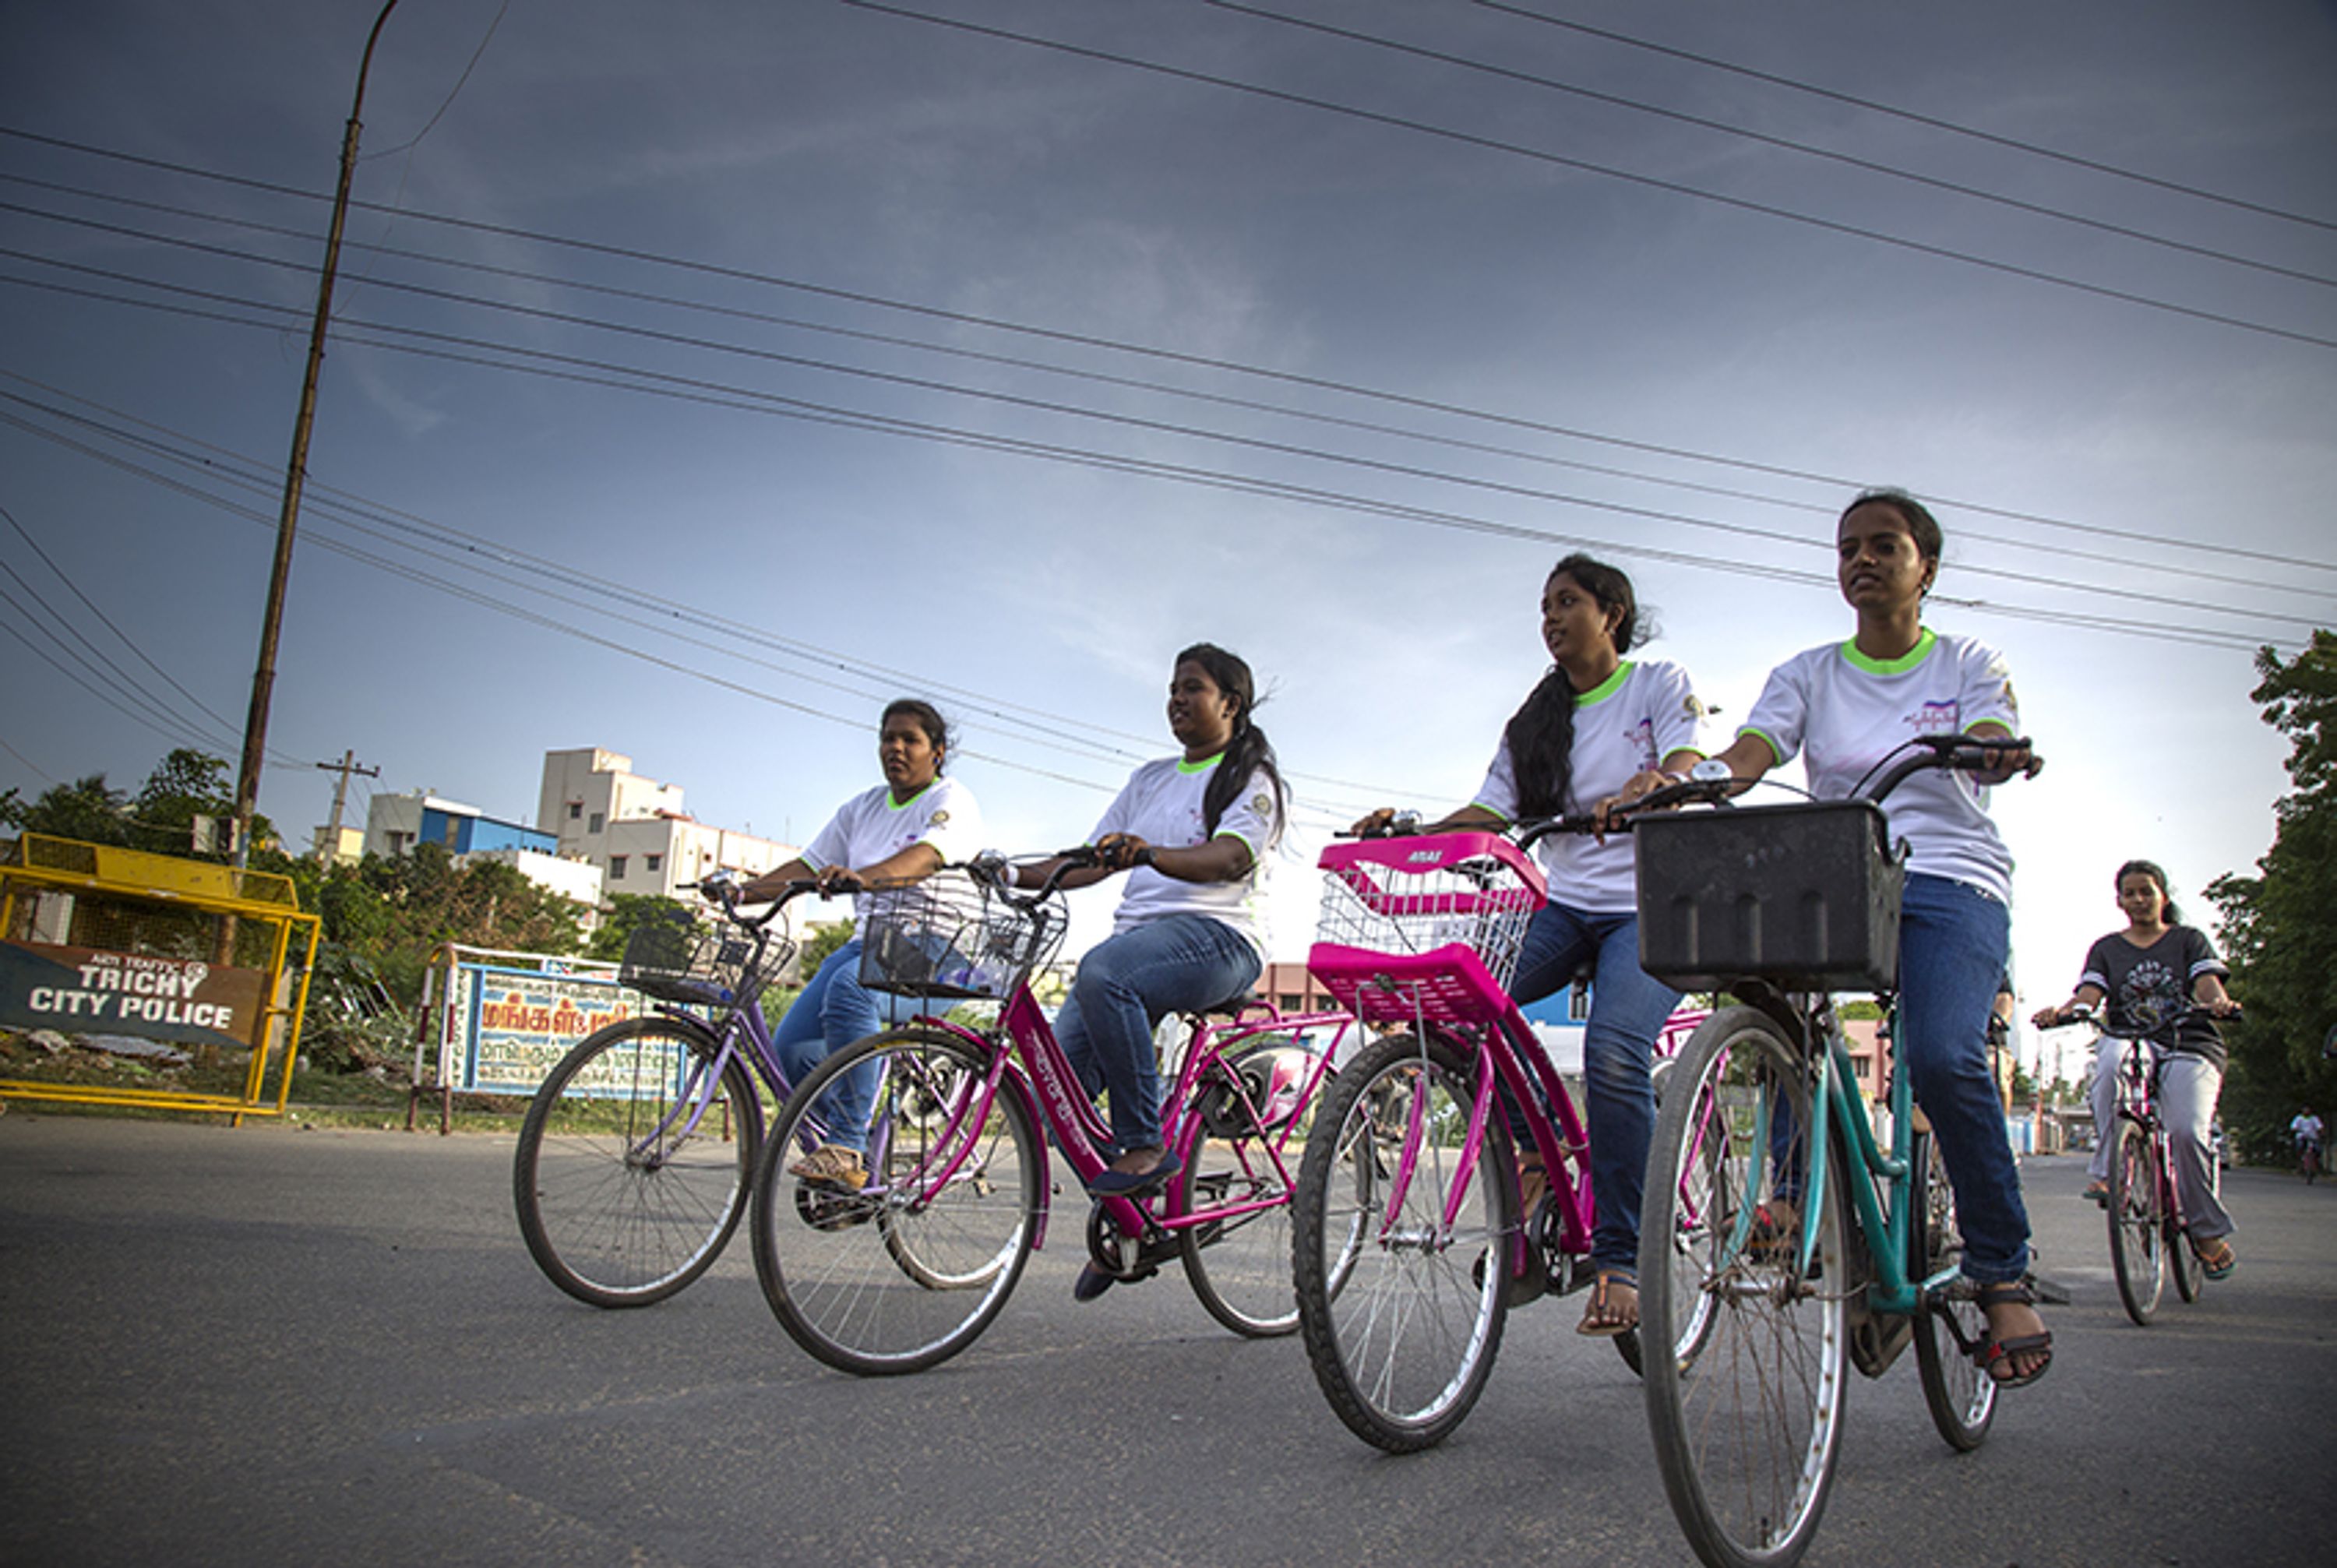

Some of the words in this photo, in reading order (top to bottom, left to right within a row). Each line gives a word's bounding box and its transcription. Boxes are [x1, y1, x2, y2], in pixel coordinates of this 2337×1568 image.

[79, 964, 201, 999] TRICHY
[30, 987, 110, 1013] CITY
[119, 995, 233, 1029] POLICE
